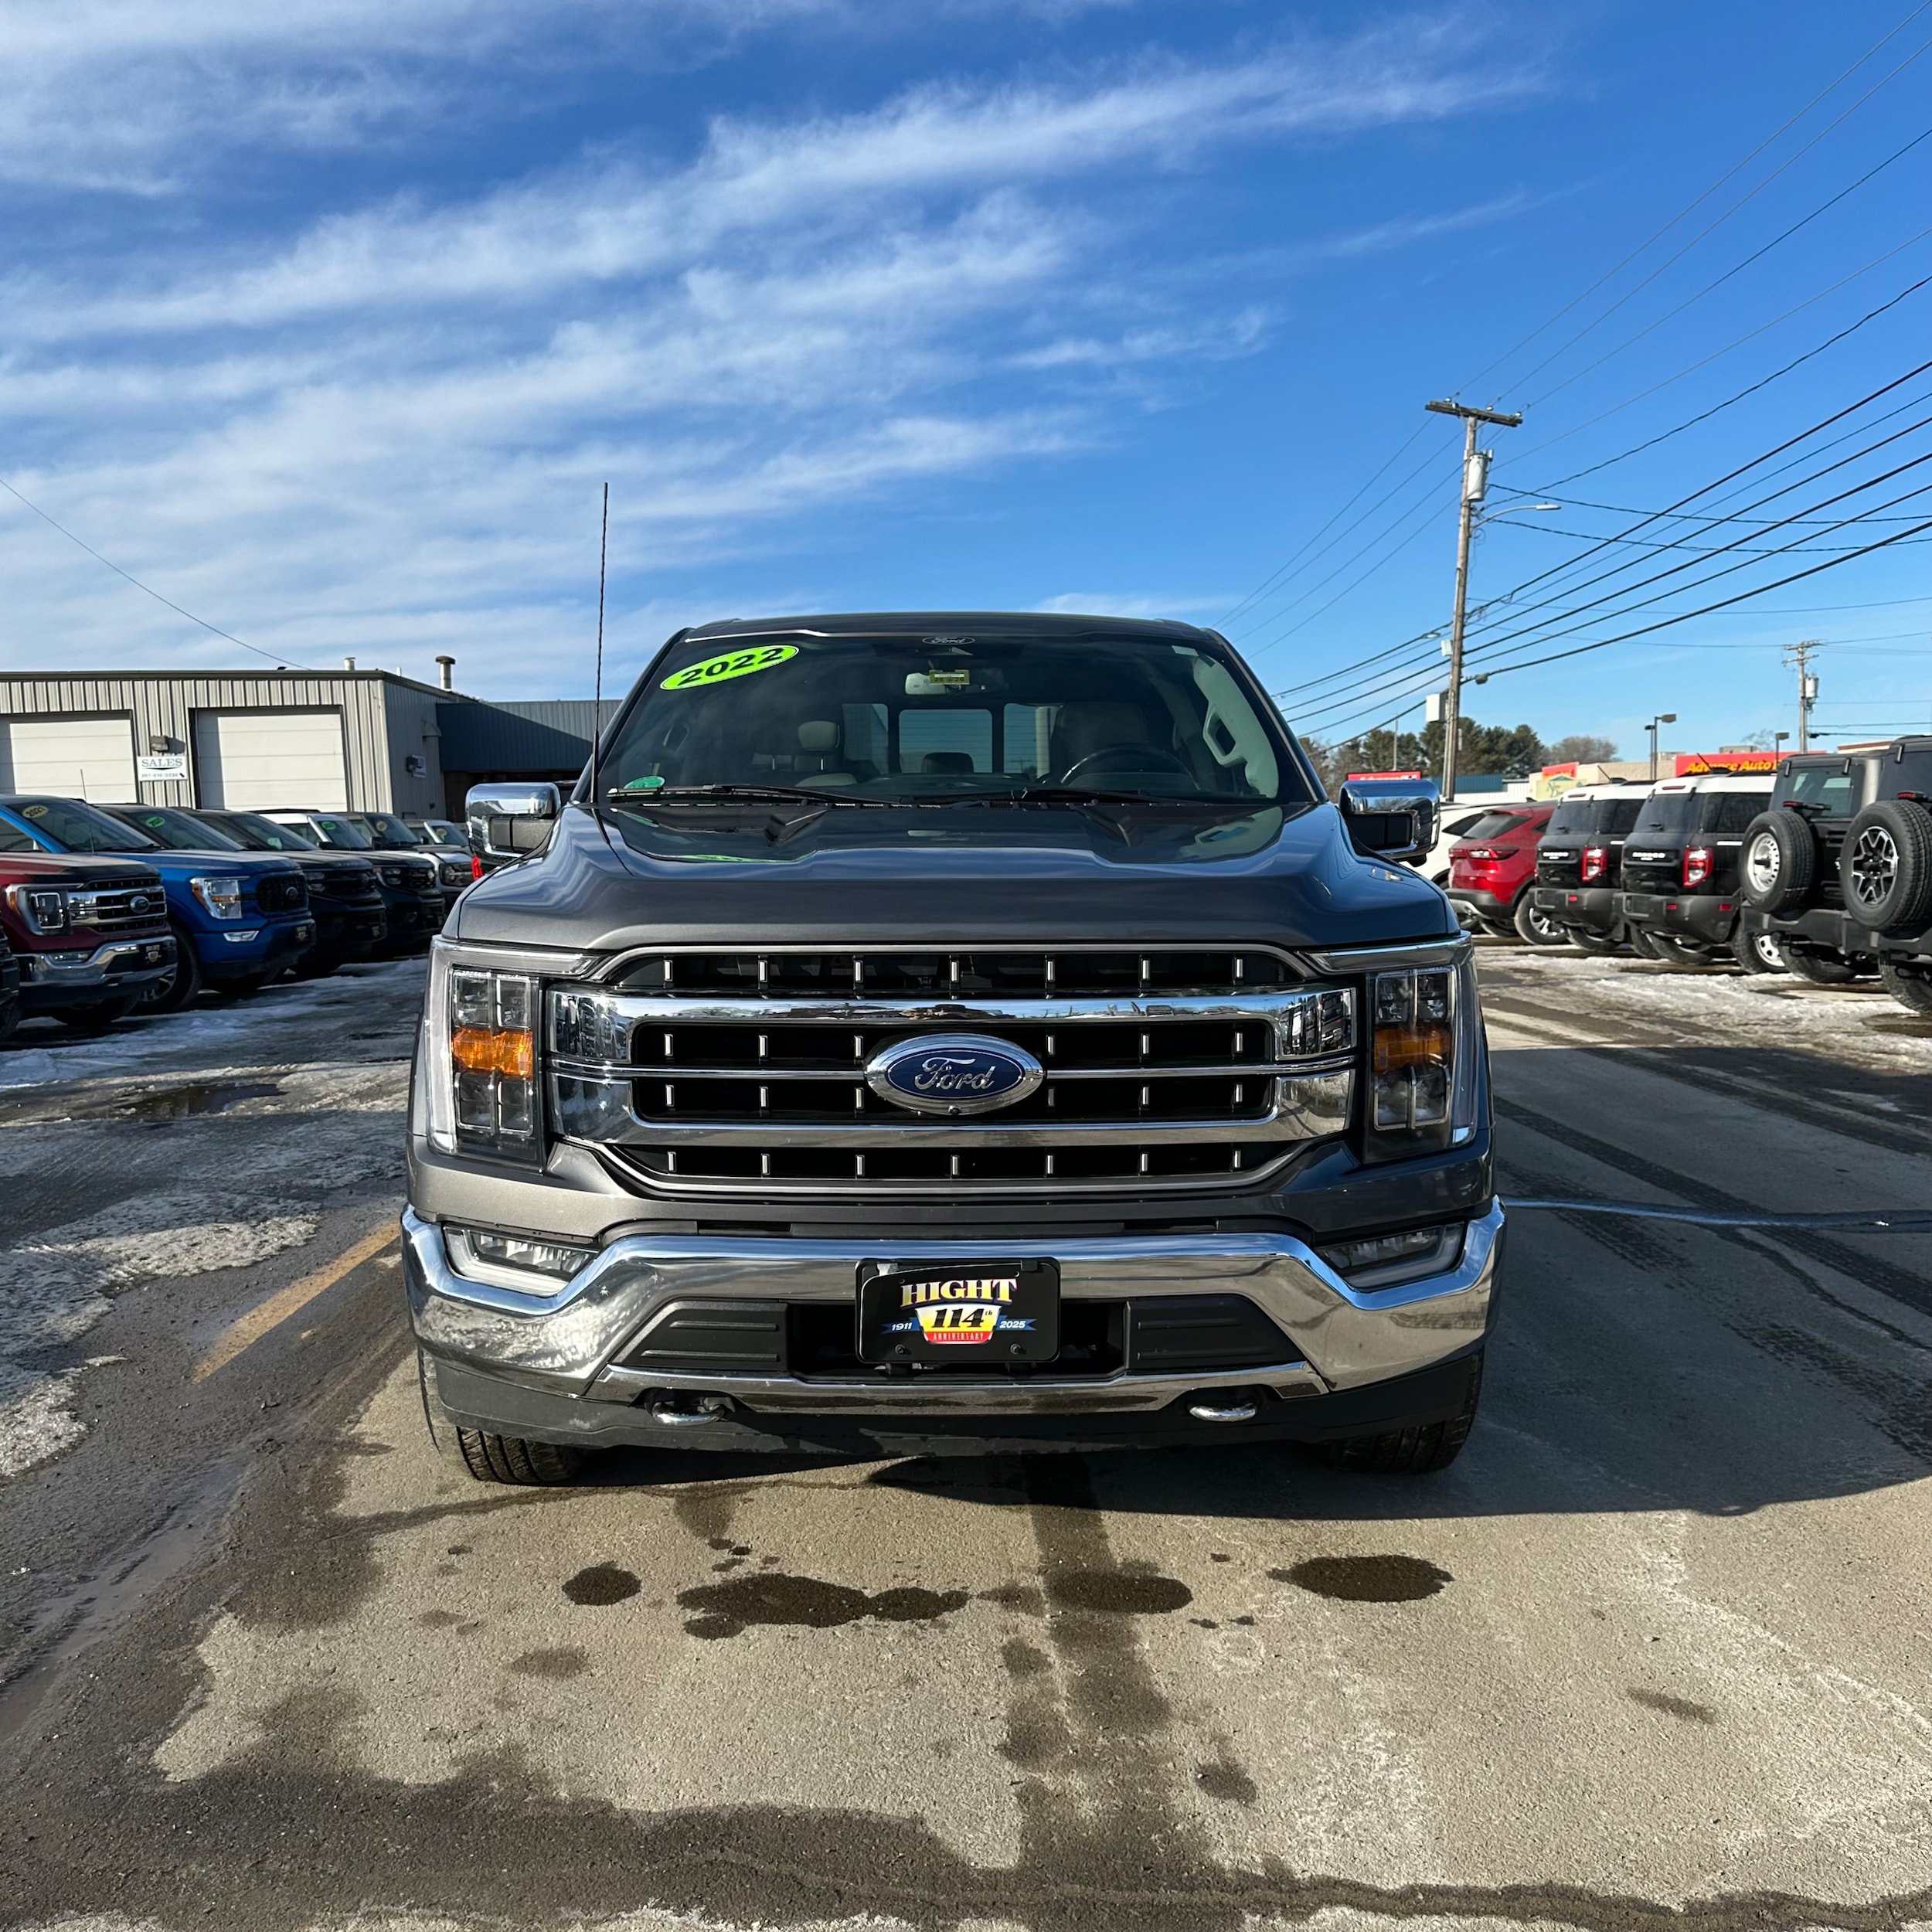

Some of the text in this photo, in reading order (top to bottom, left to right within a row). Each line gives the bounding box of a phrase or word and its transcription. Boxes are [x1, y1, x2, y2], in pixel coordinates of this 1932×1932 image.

[676, 648, 785, 686] 2022
[141, 758, 183, 767] SALES
[1740, 760, 1772, 771] Auto
[914, 1056, 996, 1090] Ford
[900, 1277, 1018, 1308] HIGHT
[892, 1322, 913, 1331] 1911
[999, 1320, 1026, 1328] 2025
[933, 1332, 984, 1341] ANNIVERSARY
